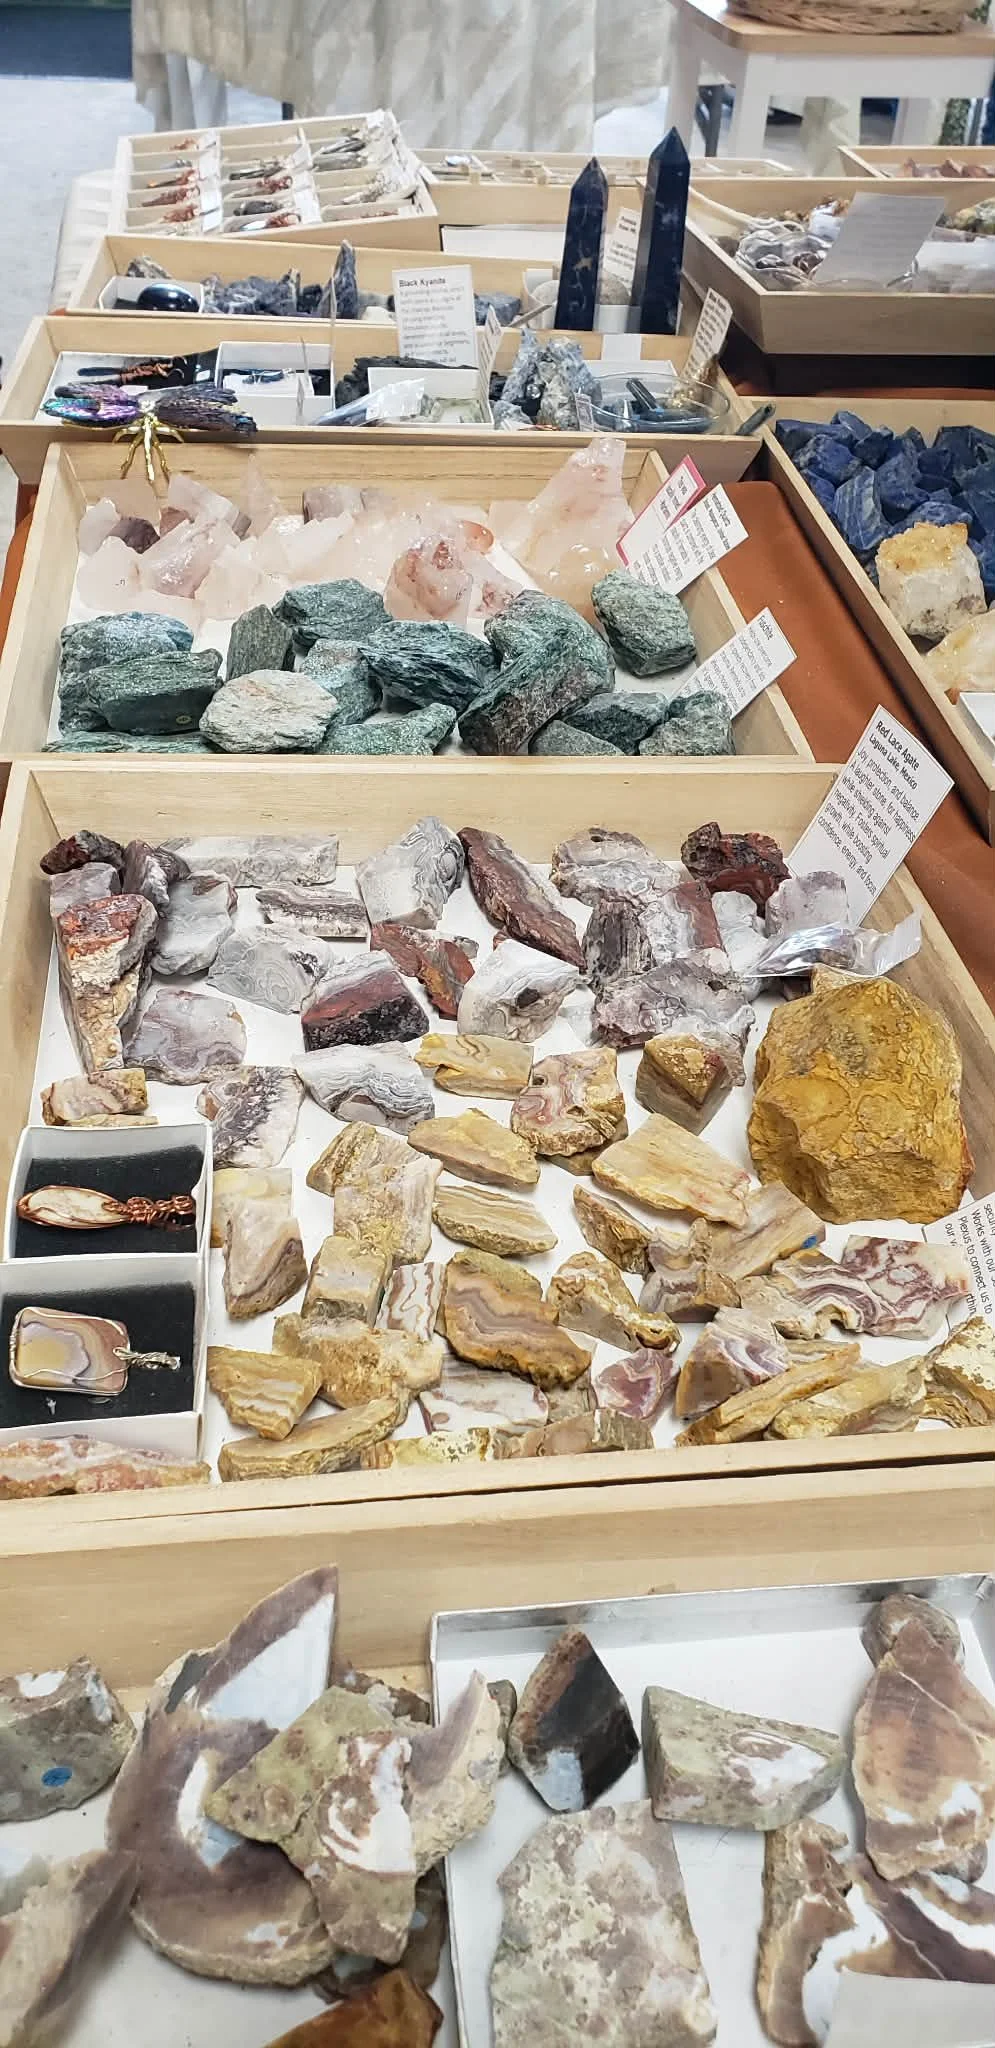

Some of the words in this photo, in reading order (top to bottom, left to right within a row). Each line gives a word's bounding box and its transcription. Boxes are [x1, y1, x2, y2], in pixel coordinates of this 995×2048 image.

[875, 720, 889, 738] Red
[887, 733, 903, 753] Lace
[901, 748, 919, 771] Agate
[869, 733, 888, 757] Laguna
[886, 752, 901, 772] Lake,
[899, 767, 917, 790] Mexico
[849, 760, 857, 771] A
[854, 764, 874, 791] laughter
[885, 801, 895, 815] for
[890, 785, 903, 800] and
[841, 774, 855, 792] while
[872, 812, 891, 836] against
[841, 821, 854, 840] while
[855, 864, 866, 880] and
[944, 1223, 955, 1237] our
[958, 1215, 971, 1244] Plexus
[972, 1209, 984, 1237] Works
[980, 1237, 992, 1257] with
[967, 1244, 975, 1255] to
[970, 1256, 986, 1290] connect
[981, 1291, 989, 1303] us
[984, 1303, 992, 1315] to
